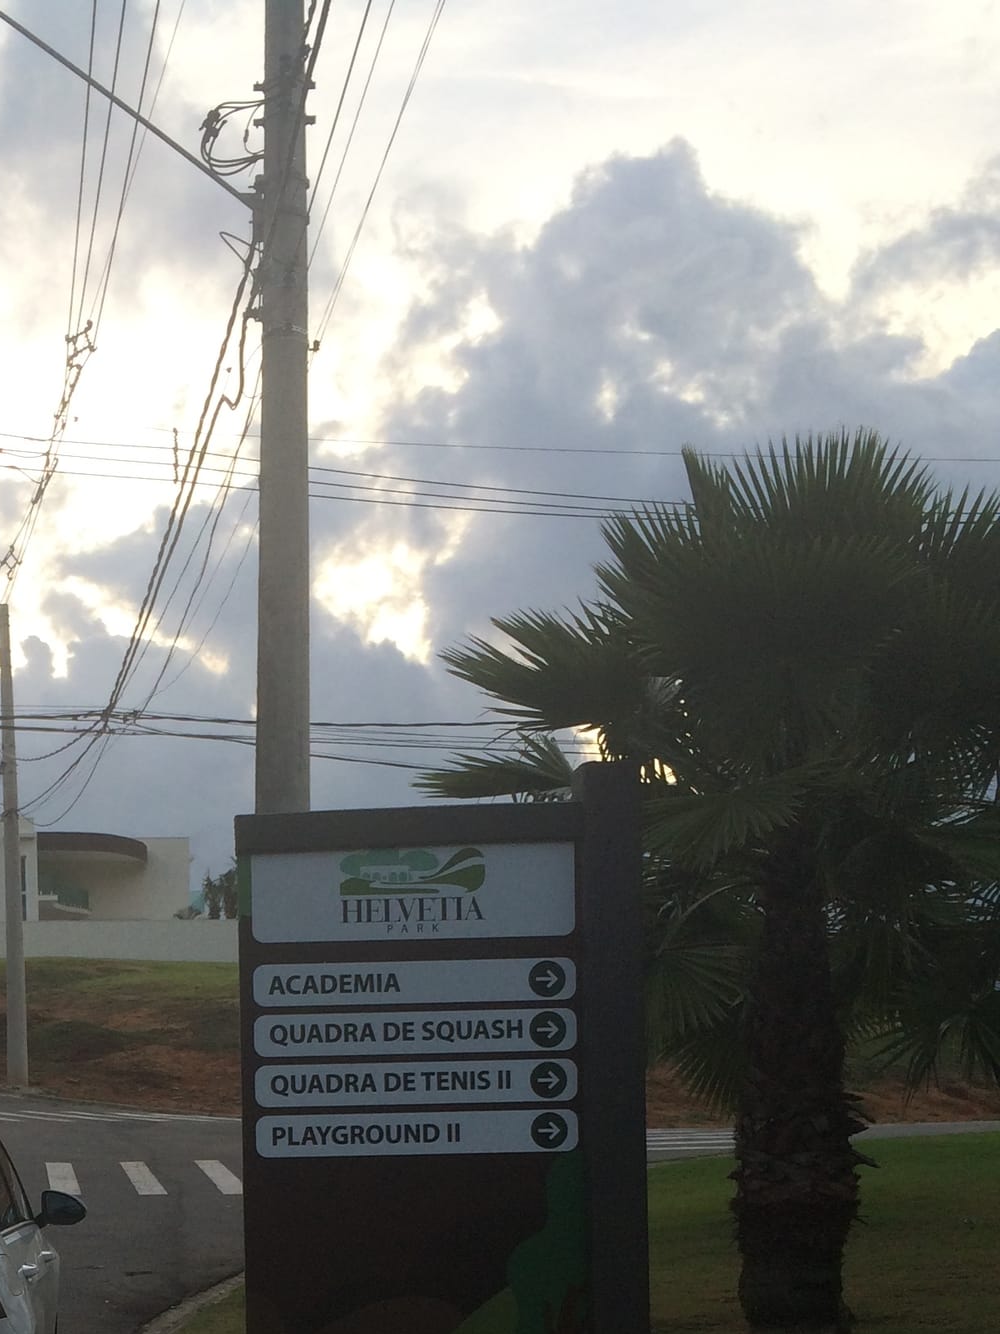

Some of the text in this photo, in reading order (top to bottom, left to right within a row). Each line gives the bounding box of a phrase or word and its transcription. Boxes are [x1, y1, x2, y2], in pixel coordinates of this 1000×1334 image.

[339, 895, 486, 924] HELVETIA
[386, 923, 440, 934] PARK
[268, 973, 401, 996] ACADEMIA
[269, 1018, 524, 1047] QUADRA DE SQUASH
[270, 1070, 512, 1098] QUADRA DE TENIS II
[271, 1122, 461, 1147] PLAYGROUND II
